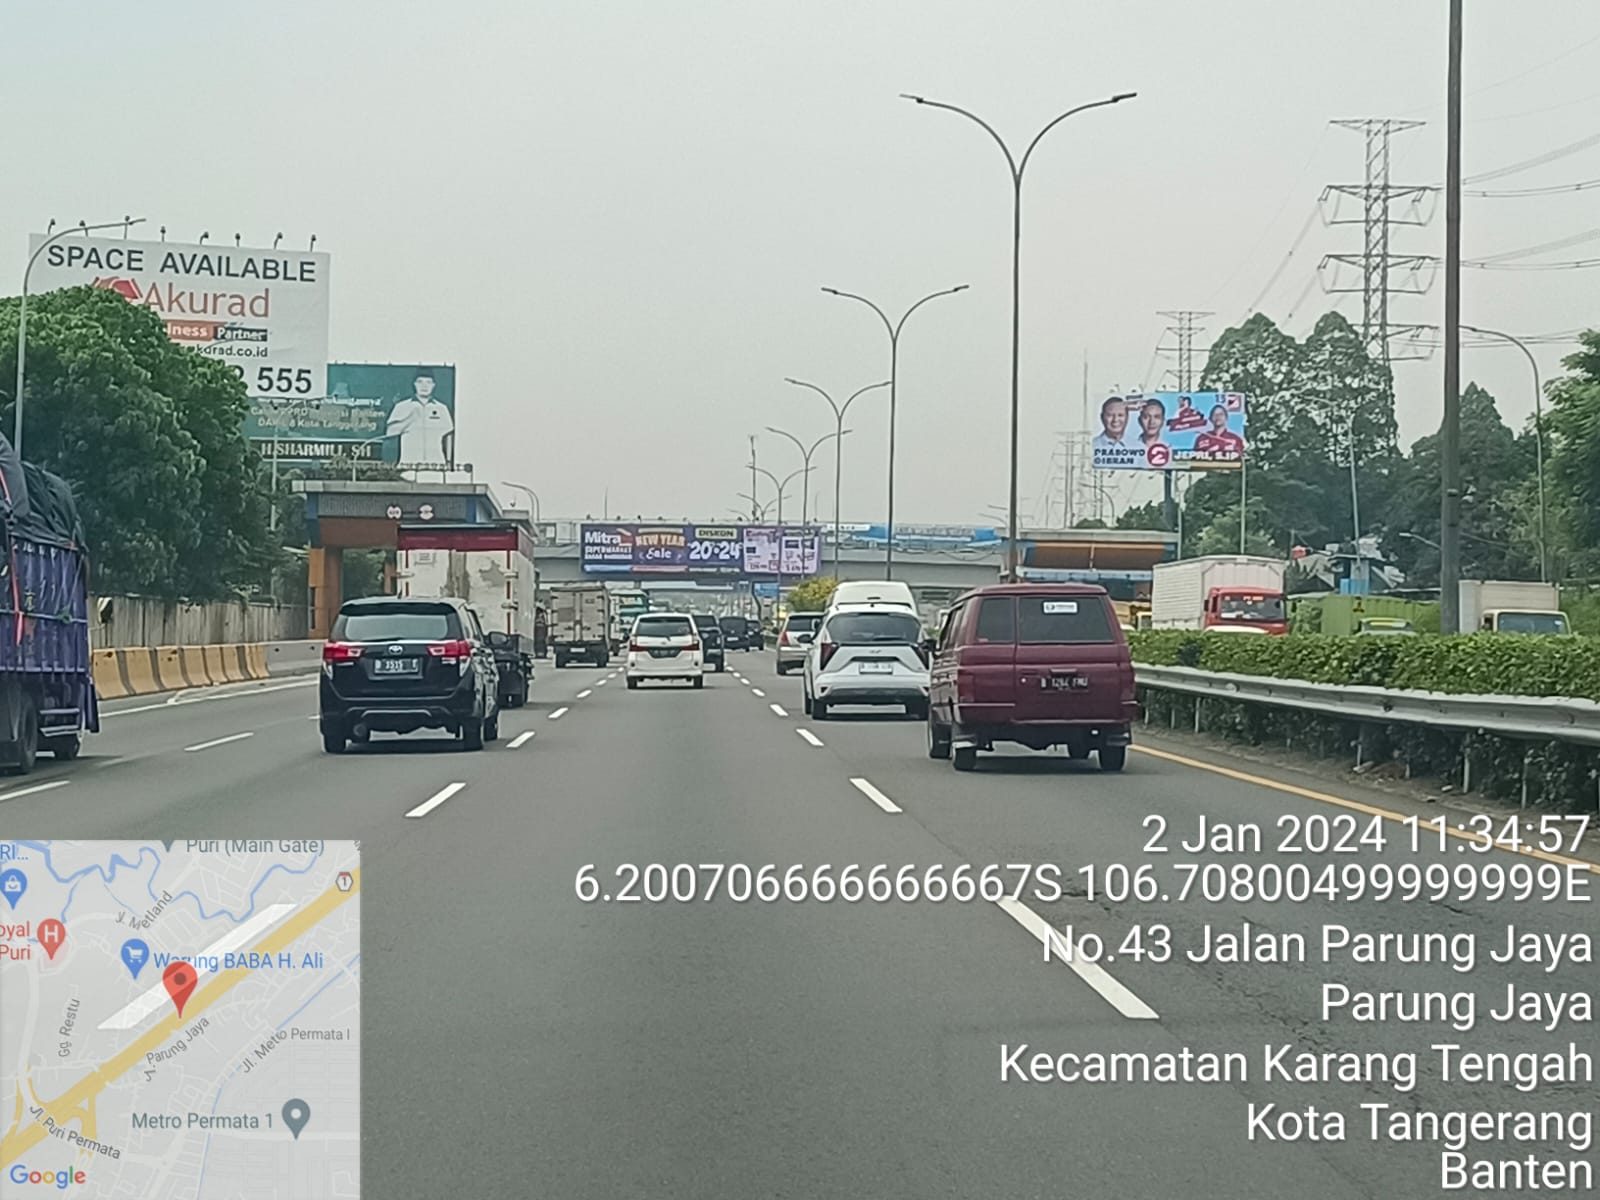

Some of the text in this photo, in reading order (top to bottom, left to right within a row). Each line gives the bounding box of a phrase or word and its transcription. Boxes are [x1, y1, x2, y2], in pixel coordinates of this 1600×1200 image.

[48, 245, 316, 283] SPACE AVAILABLE
[145, 282, 270, 318] Akurad
[165, 322, 208, 338] iness
[257, 366, 313, 394] 555
[1094, 448, 1146, 457] PRABOWO
[1151, 446, 1167, 465] 2
[584, 531, 621, 545] Mitra
